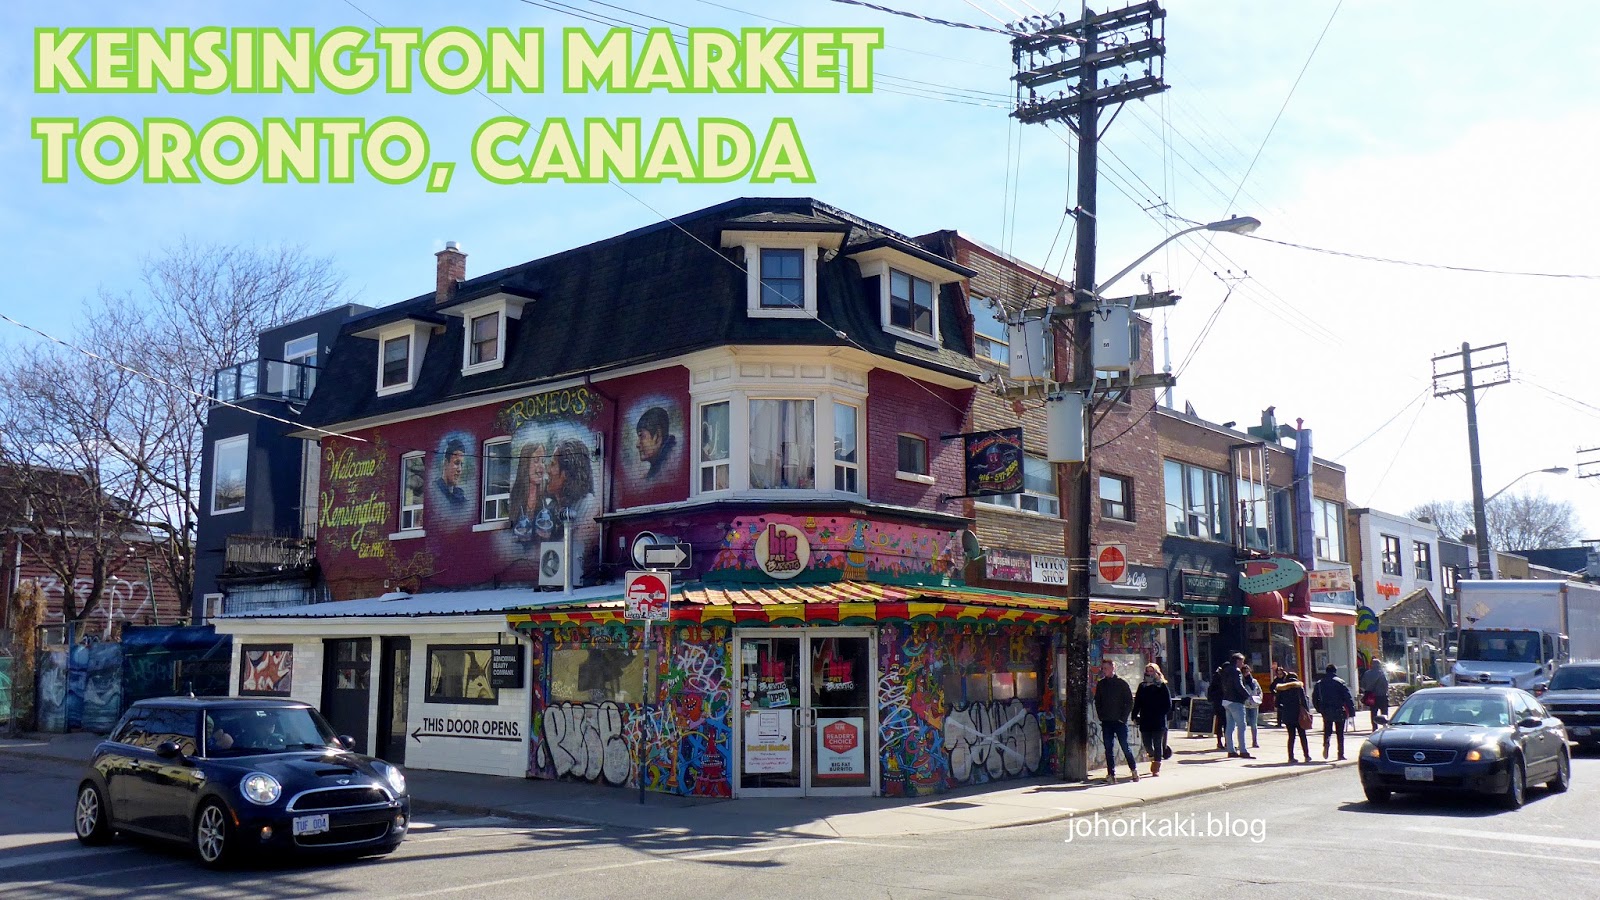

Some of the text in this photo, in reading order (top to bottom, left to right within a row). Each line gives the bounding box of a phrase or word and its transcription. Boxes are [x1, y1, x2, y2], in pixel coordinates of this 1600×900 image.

[319, 489, 387, 550] Kensington
[1033, 555, 1066, 571] TATTOO
[1041, 569, 1065, 584] SHOP
[423, 718, 521, 737] THIS DOOR OPENS.
